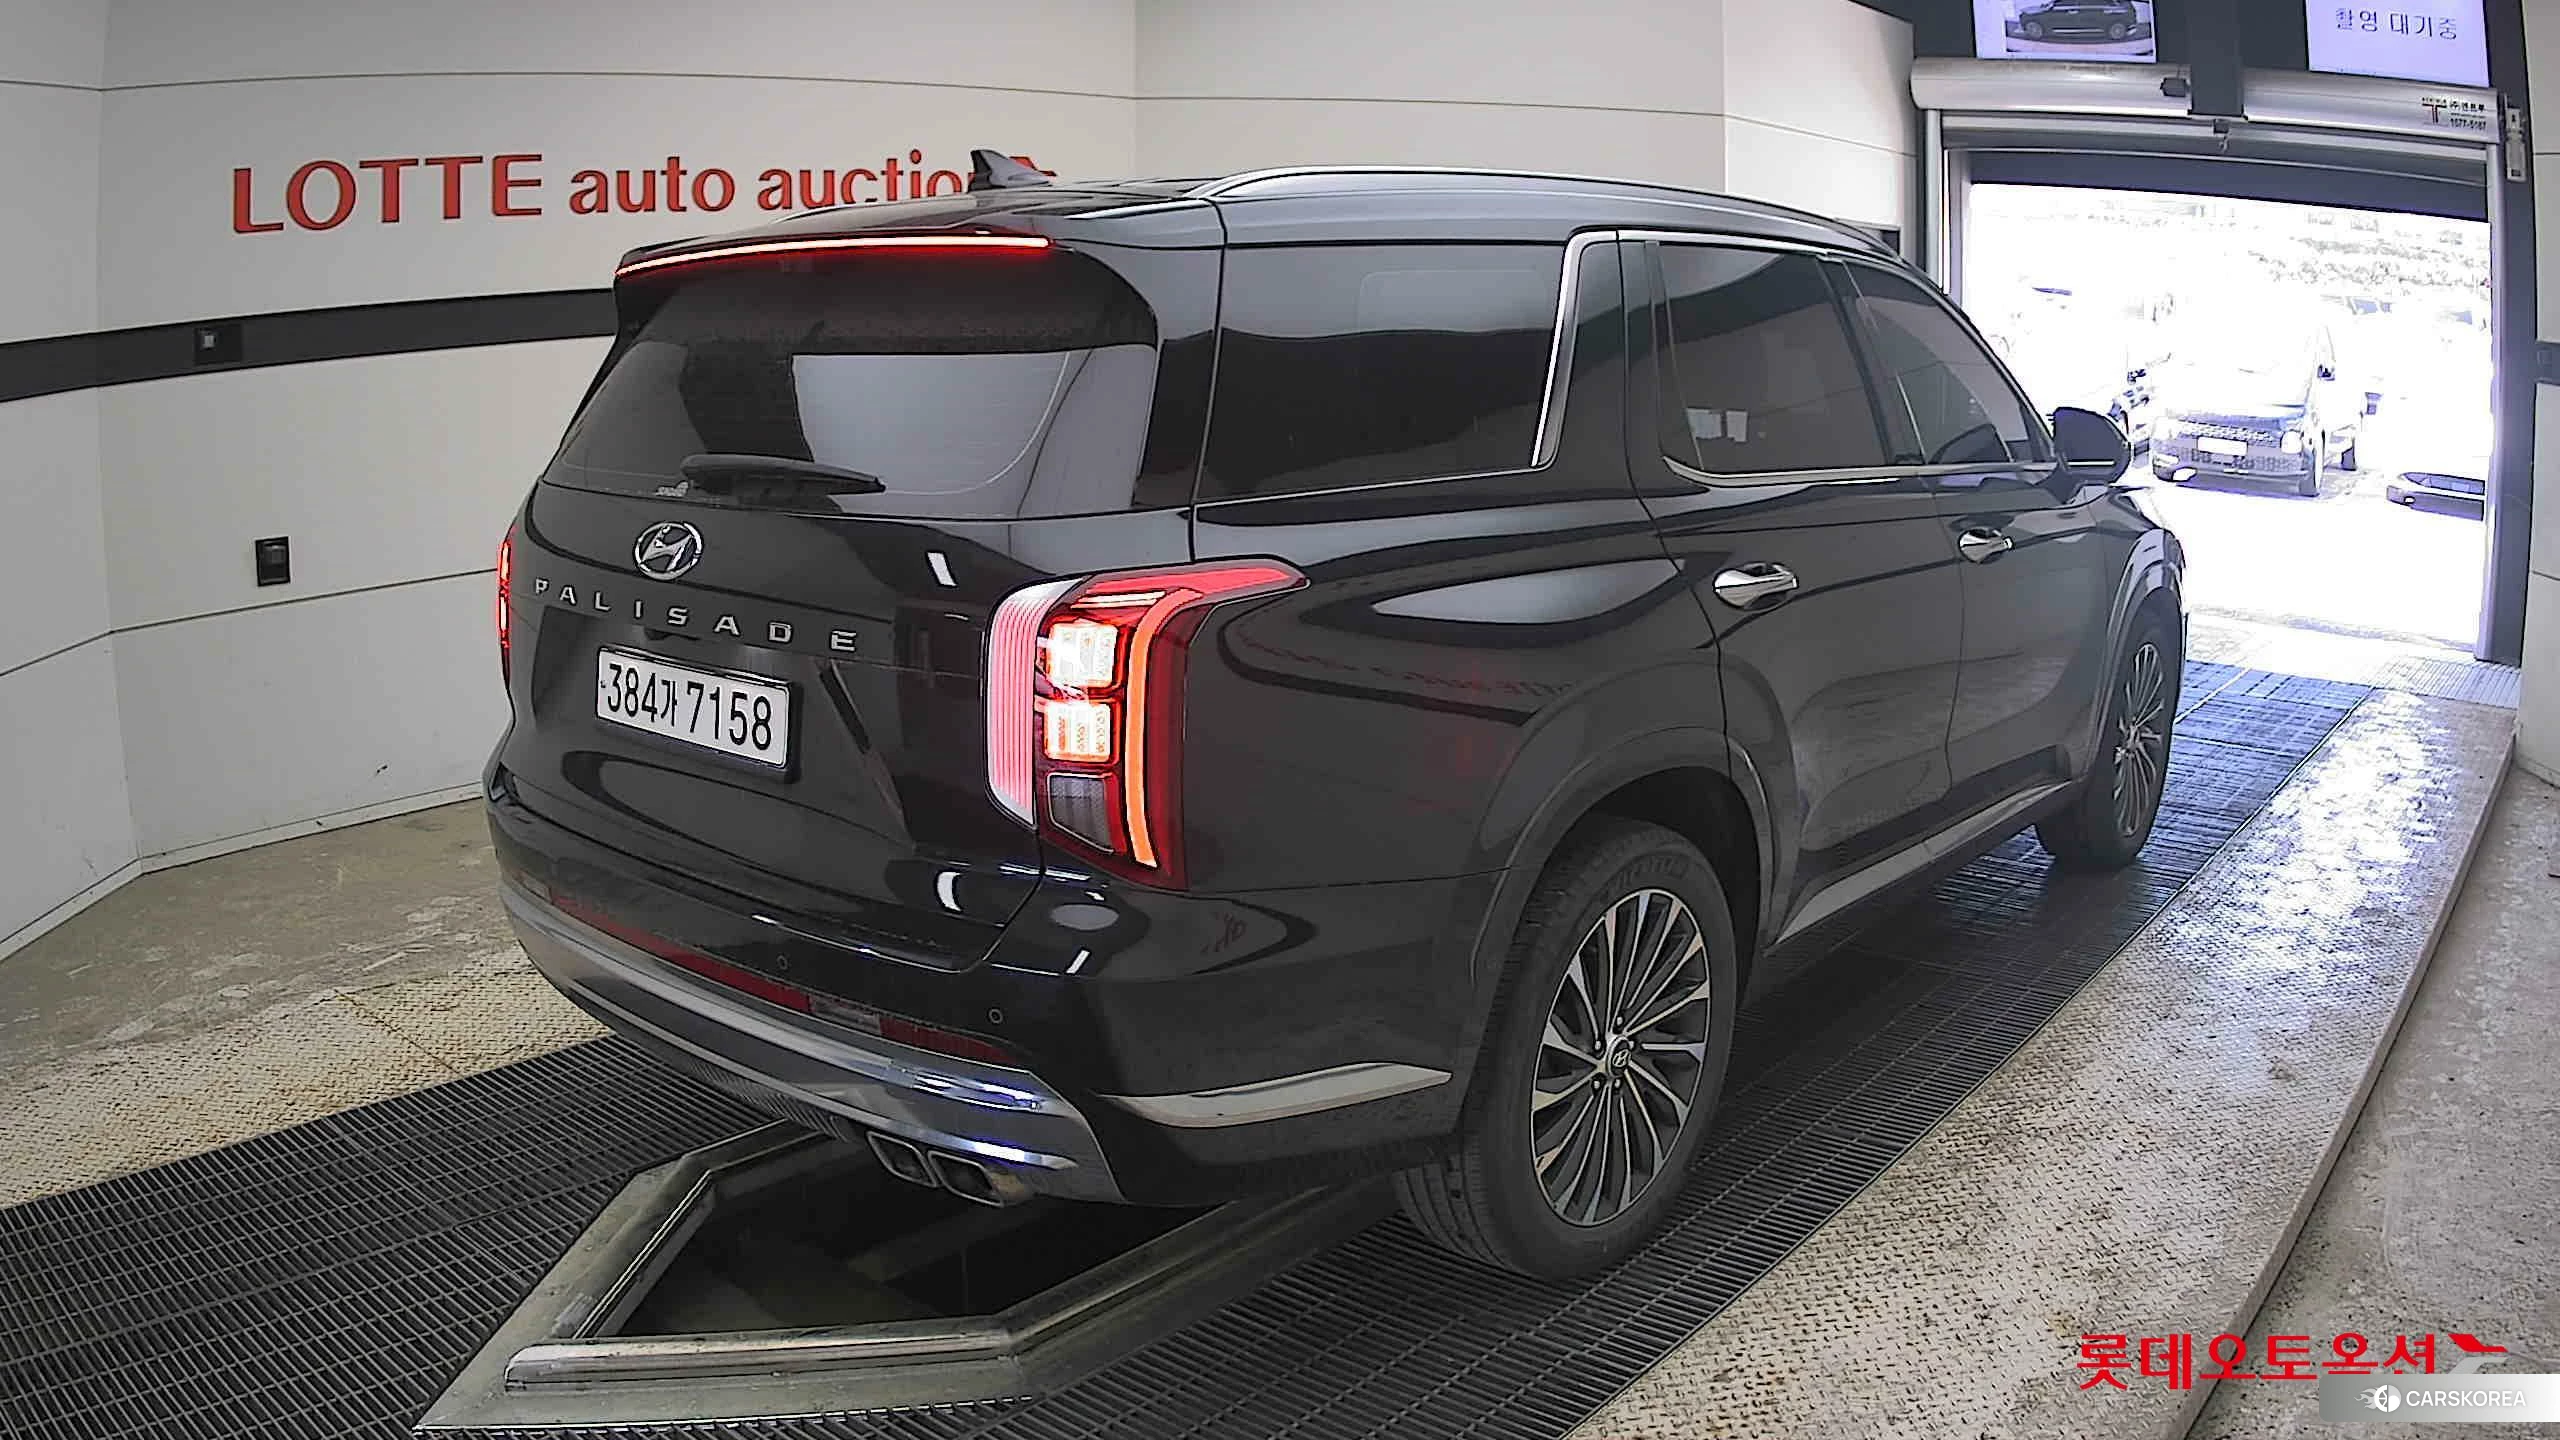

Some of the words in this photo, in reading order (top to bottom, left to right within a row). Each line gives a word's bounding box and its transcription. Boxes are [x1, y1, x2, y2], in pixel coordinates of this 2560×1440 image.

[2390, 13, 2457, 40] 대기중
[233, 154, 542, 233] LOTTE
[569, 156, 736, 214] auto
[757, 149, 975, 210] auctio
[535, 577, 857, 652] PALISADE
